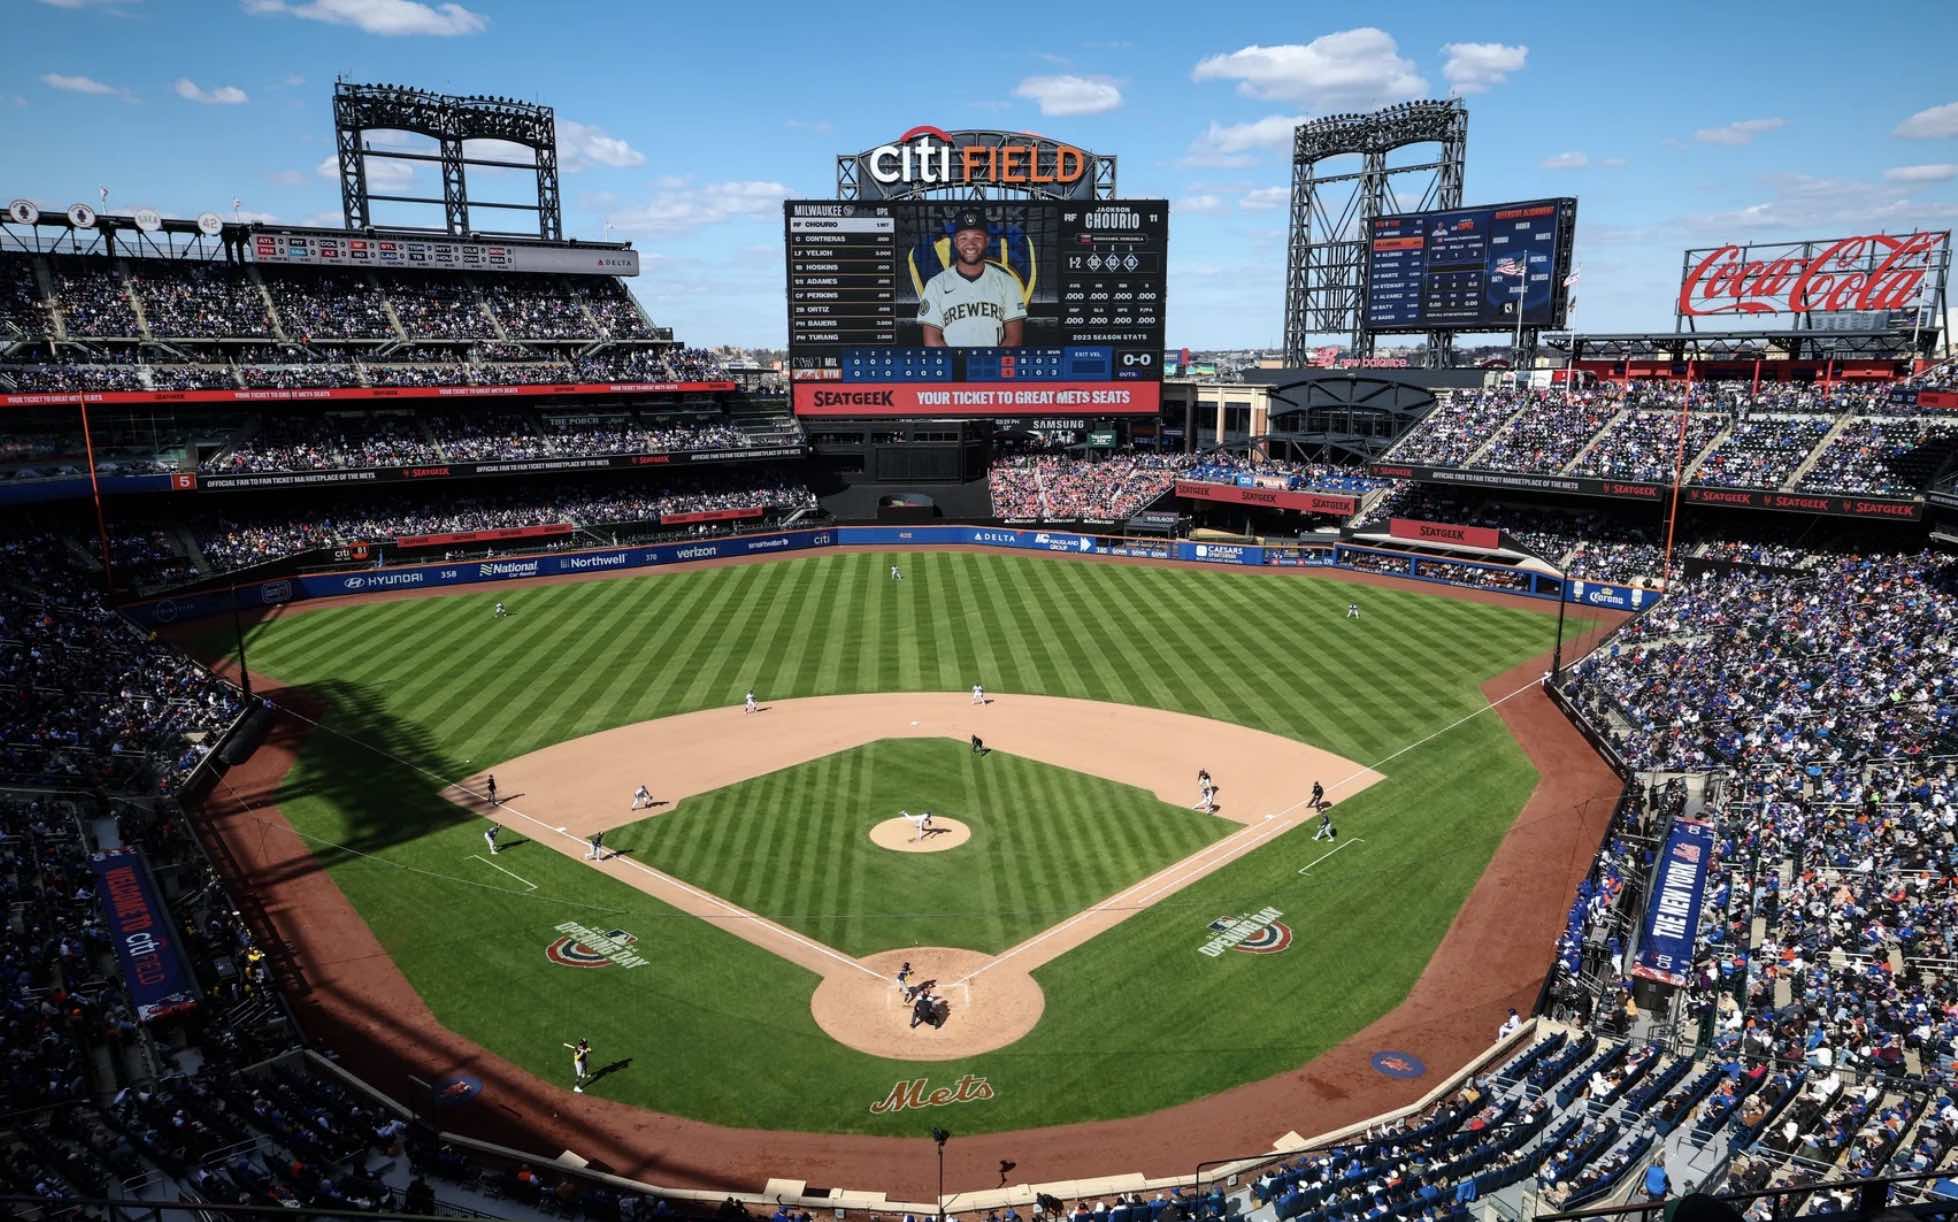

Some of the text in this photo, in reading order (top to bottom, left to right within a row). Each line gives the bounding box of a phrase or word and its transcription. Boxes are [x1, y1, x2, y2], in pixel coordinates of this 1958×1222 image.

[870, 135, 1085, 183] citi FIELD
[794, 205, 842, 216] MILWAUKEE
[203, 218, 217, 229] 42
[1064, 213, 1078, 221] RF
[1085, 212, 1140, 229] CHOURIO
[1149, 214, 1158, 222] 11
[943, 302, 1005, 327] BREWERS
[1123, 353, 1152, 366] 0-0
[814, 390, 1130, 407] SEATGEEK YOUR TICKET TO GREAT METS SEATS
[569, 417, 600, 425] PORCH
[1033, 420, 1084, 429] SAMSUNG
[179, 476, 190, 487] 5
[1613, 485, 1657, 497] SEATGEEK
[1703, 491, 1751, 504] SEATGEEK
[1312, 498, 1350, 512] SEATGEEK
[1776, 496, 1830, 511] SEATGEEK
[1856, 502, 1914, 516] SEATGEEK
[814, 534, 830, 545] citi
[984, 532, 1016, 542] DELTA
[1420, 526, 1464, 541] SEATGEEK
[677, 546, 717, 558] verizon
[1208, 545, 1243, 555] CAESARS
[493, 560, 538, 573] National
[571, 554, 625, 569] Northwell
[368, 573, 423, 586] HYUNDAI
[441, 570, 457, 579] 358
[1589, 592, 1624, 605] Corona
[1664, 860, 1698, 890] YORK
[105, 865, 149, 918] WELCOME
[1658, 887, 1692, 918] NEW
[120, 912, 152, 933] TO
[1652, 913, 1688, 940] THE
[125, 933, 161, 957] citi
[869, 1074, 994, 1114] Mets
